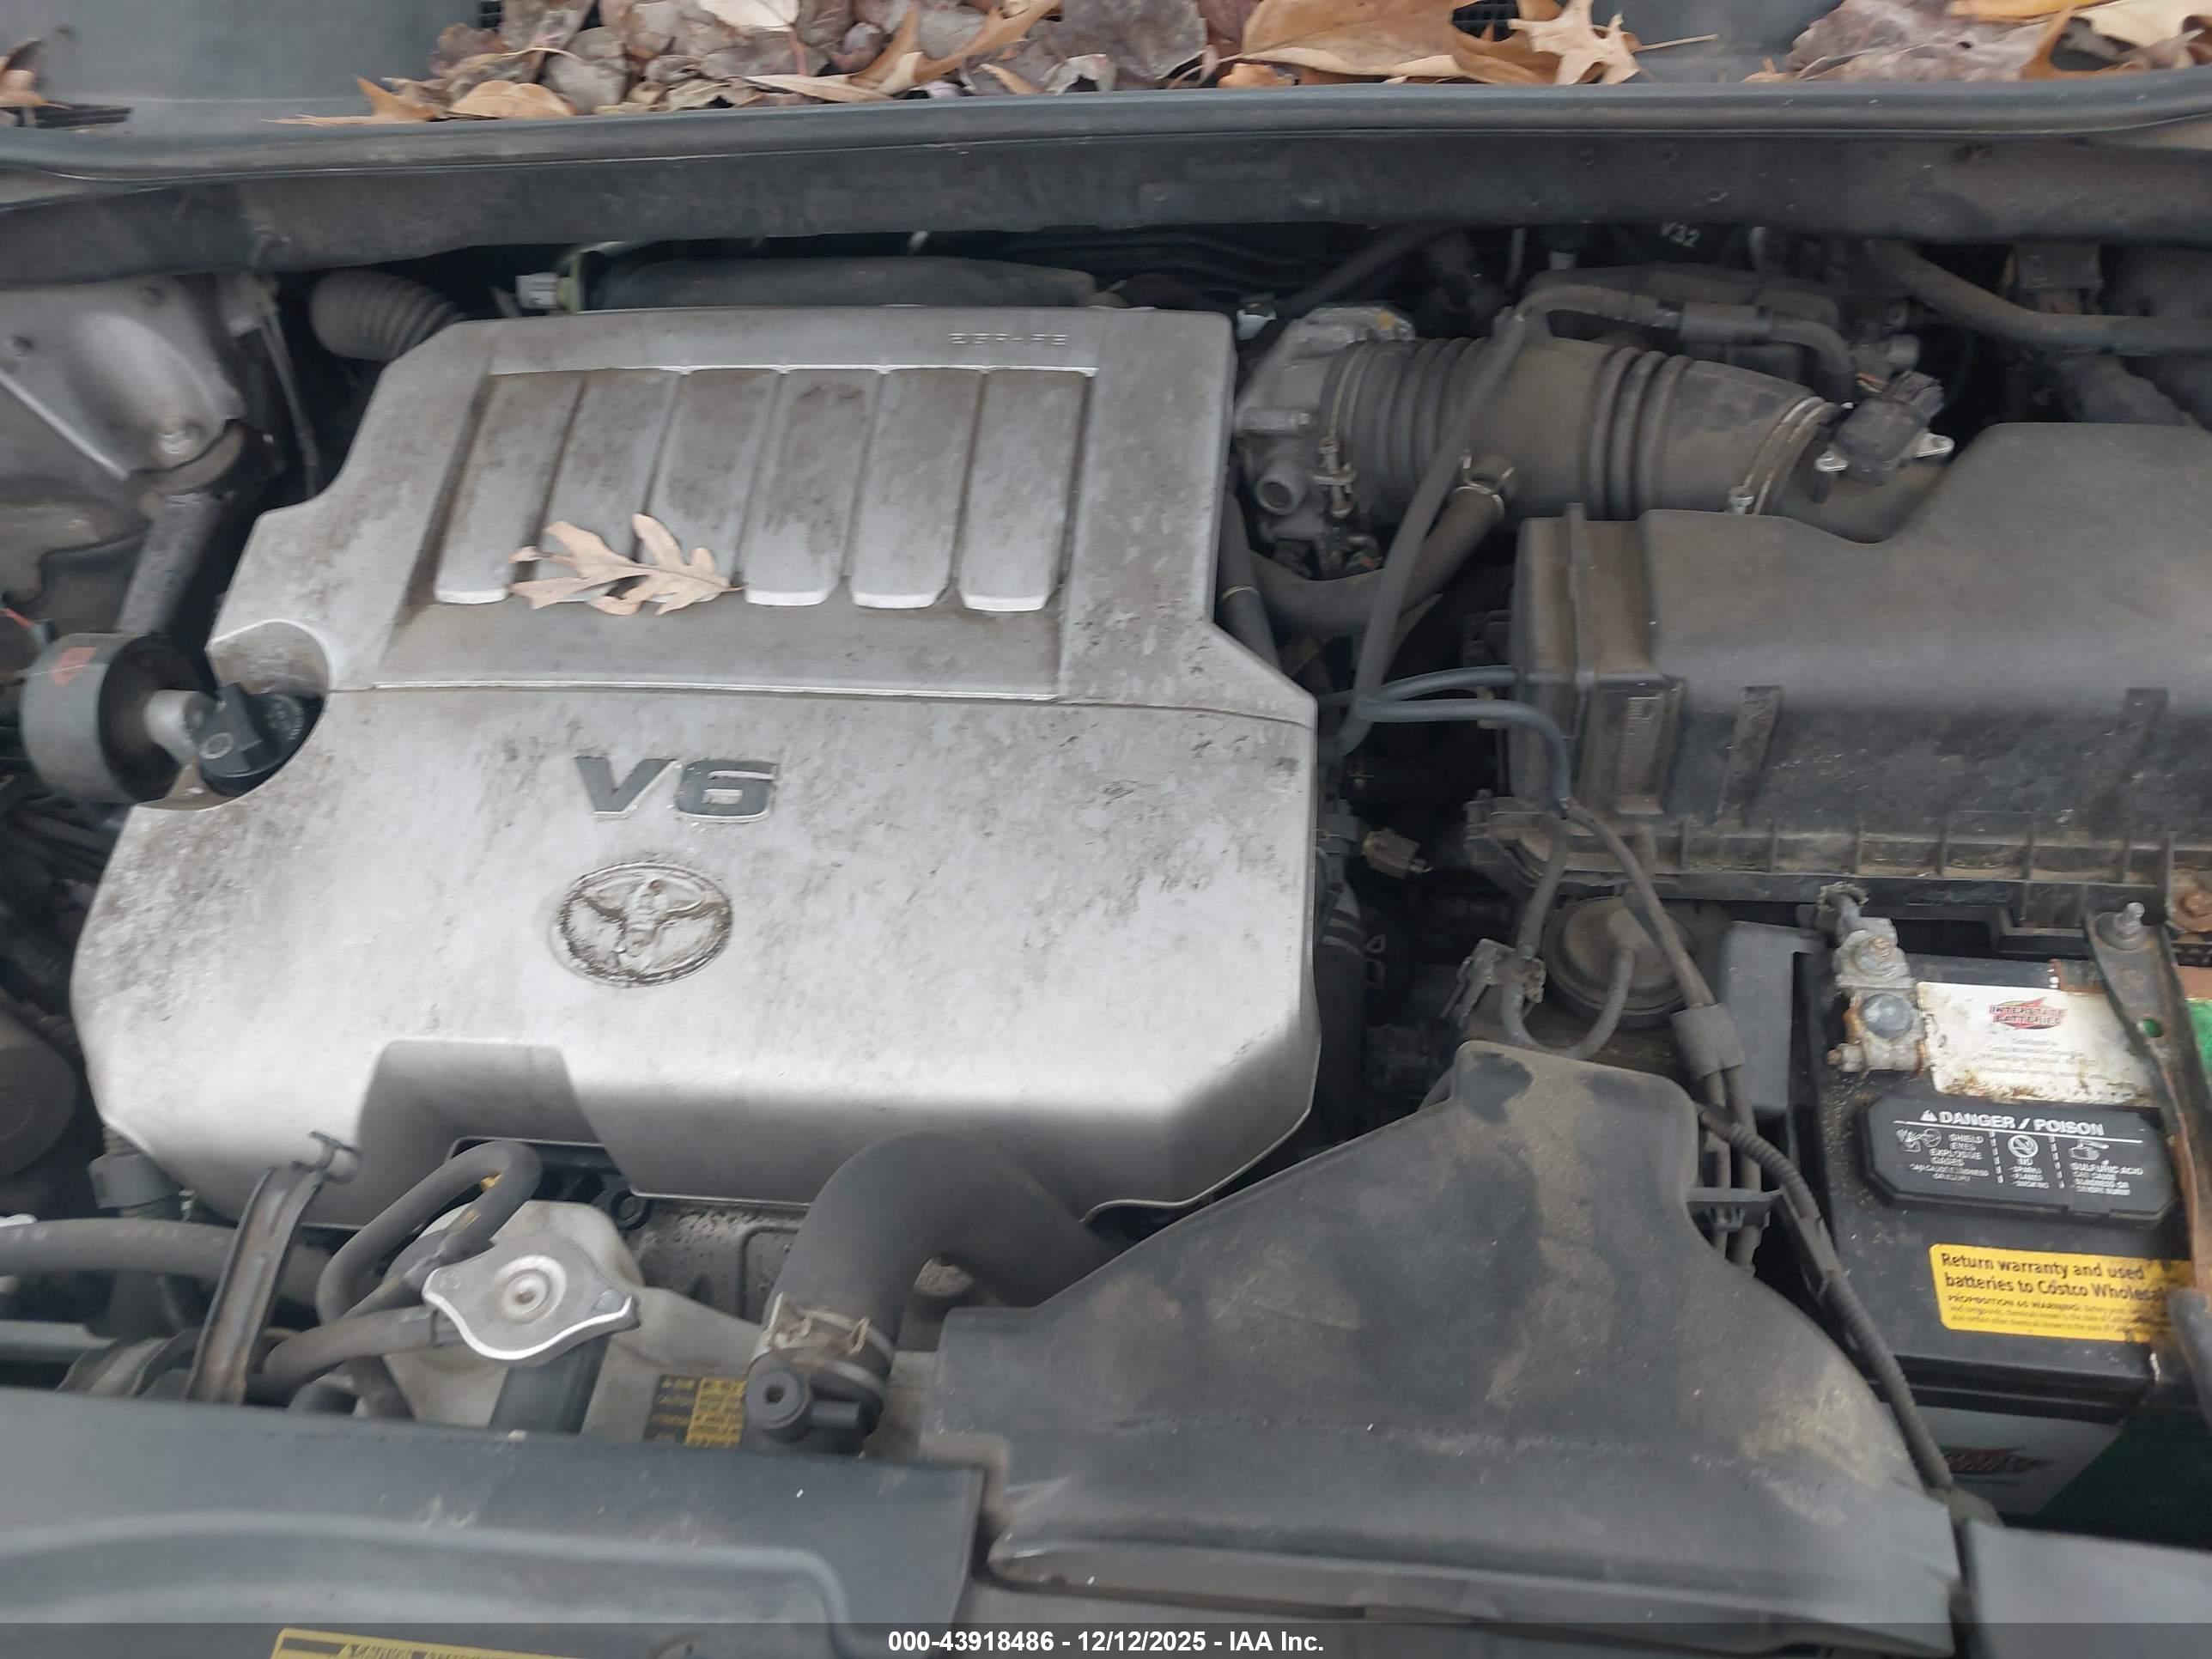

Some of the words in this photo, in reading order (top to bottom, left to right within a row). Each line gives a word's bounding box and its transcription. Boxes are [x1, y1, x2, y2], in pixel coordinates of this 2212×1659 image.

[573, 754, 779, 822] V6
[1989, 1003, 2068, 1017] INTERSTATE
[1938, 1110, 2016, 1129] DANGER
[2018, 1117, 2031, 1130] /
[2033, 1118, 2105, 1136] POISON
[1941, 1252, 1995, 1271] Return
[1996, 1259, 2069, 1279] warranty
[2073, 1261, 2103, 1278] and
[2106, 1264, 2146, 1280] used
[1943, 1271, 2014, 1292] batteries
[2017, 1279, 2035, 1293] to
[2037, 1279, 2089, 1297] Costco
